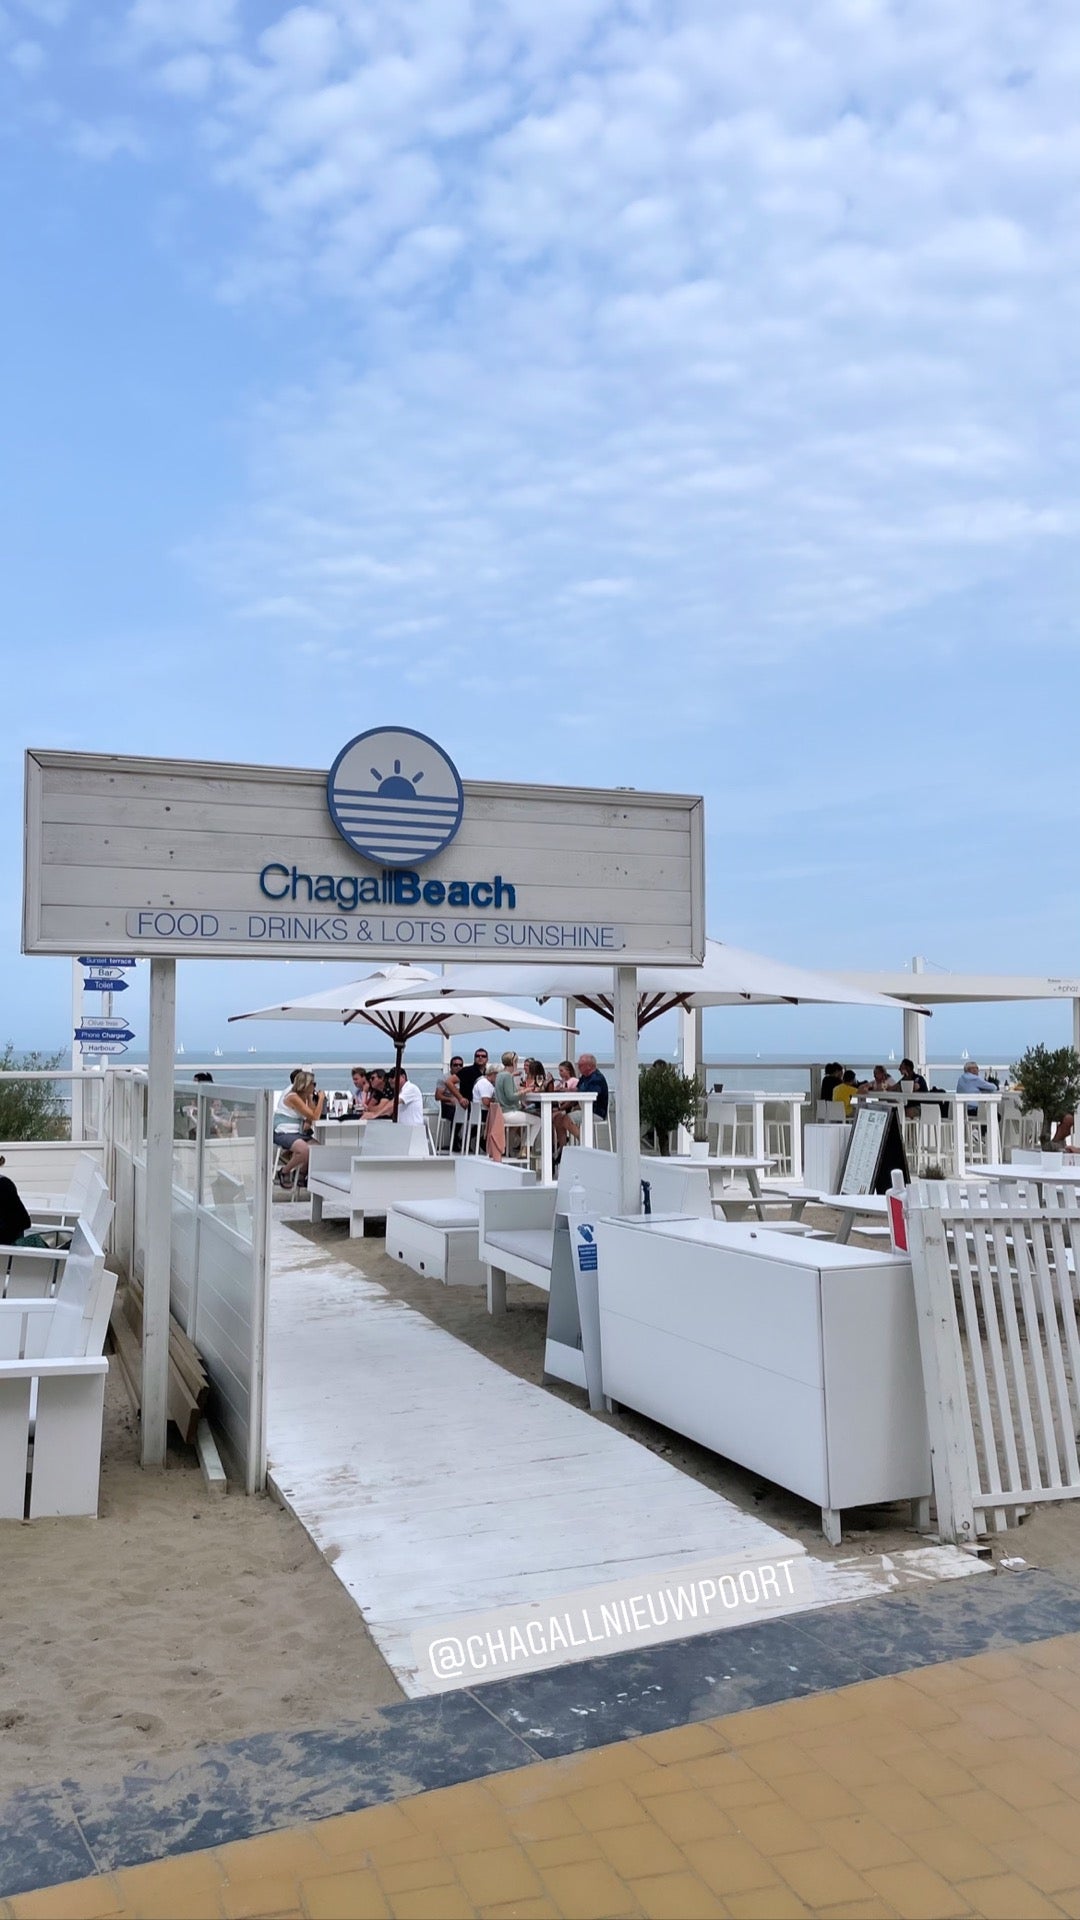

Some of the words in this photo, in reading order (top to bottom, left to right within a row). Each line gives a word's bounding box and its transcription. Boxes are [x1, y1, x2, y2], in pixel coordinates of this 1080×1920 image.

[259, 863, 516, 911] ChagallBeach
[137, 912, 219, 937] FOOD
[248, 915, 349, 941] DRINKS
[356, 919, 373, 942] &
[381, 920, 446, 943] LOTS
[454, 922, 487, 945] OF
[494, 923, 615, 948] SUNSHINE
[98, 969, 114, 977] Bar
[95, 981, 114, 989] Toilet
[88, 1043, 116, 1052] Harbour
